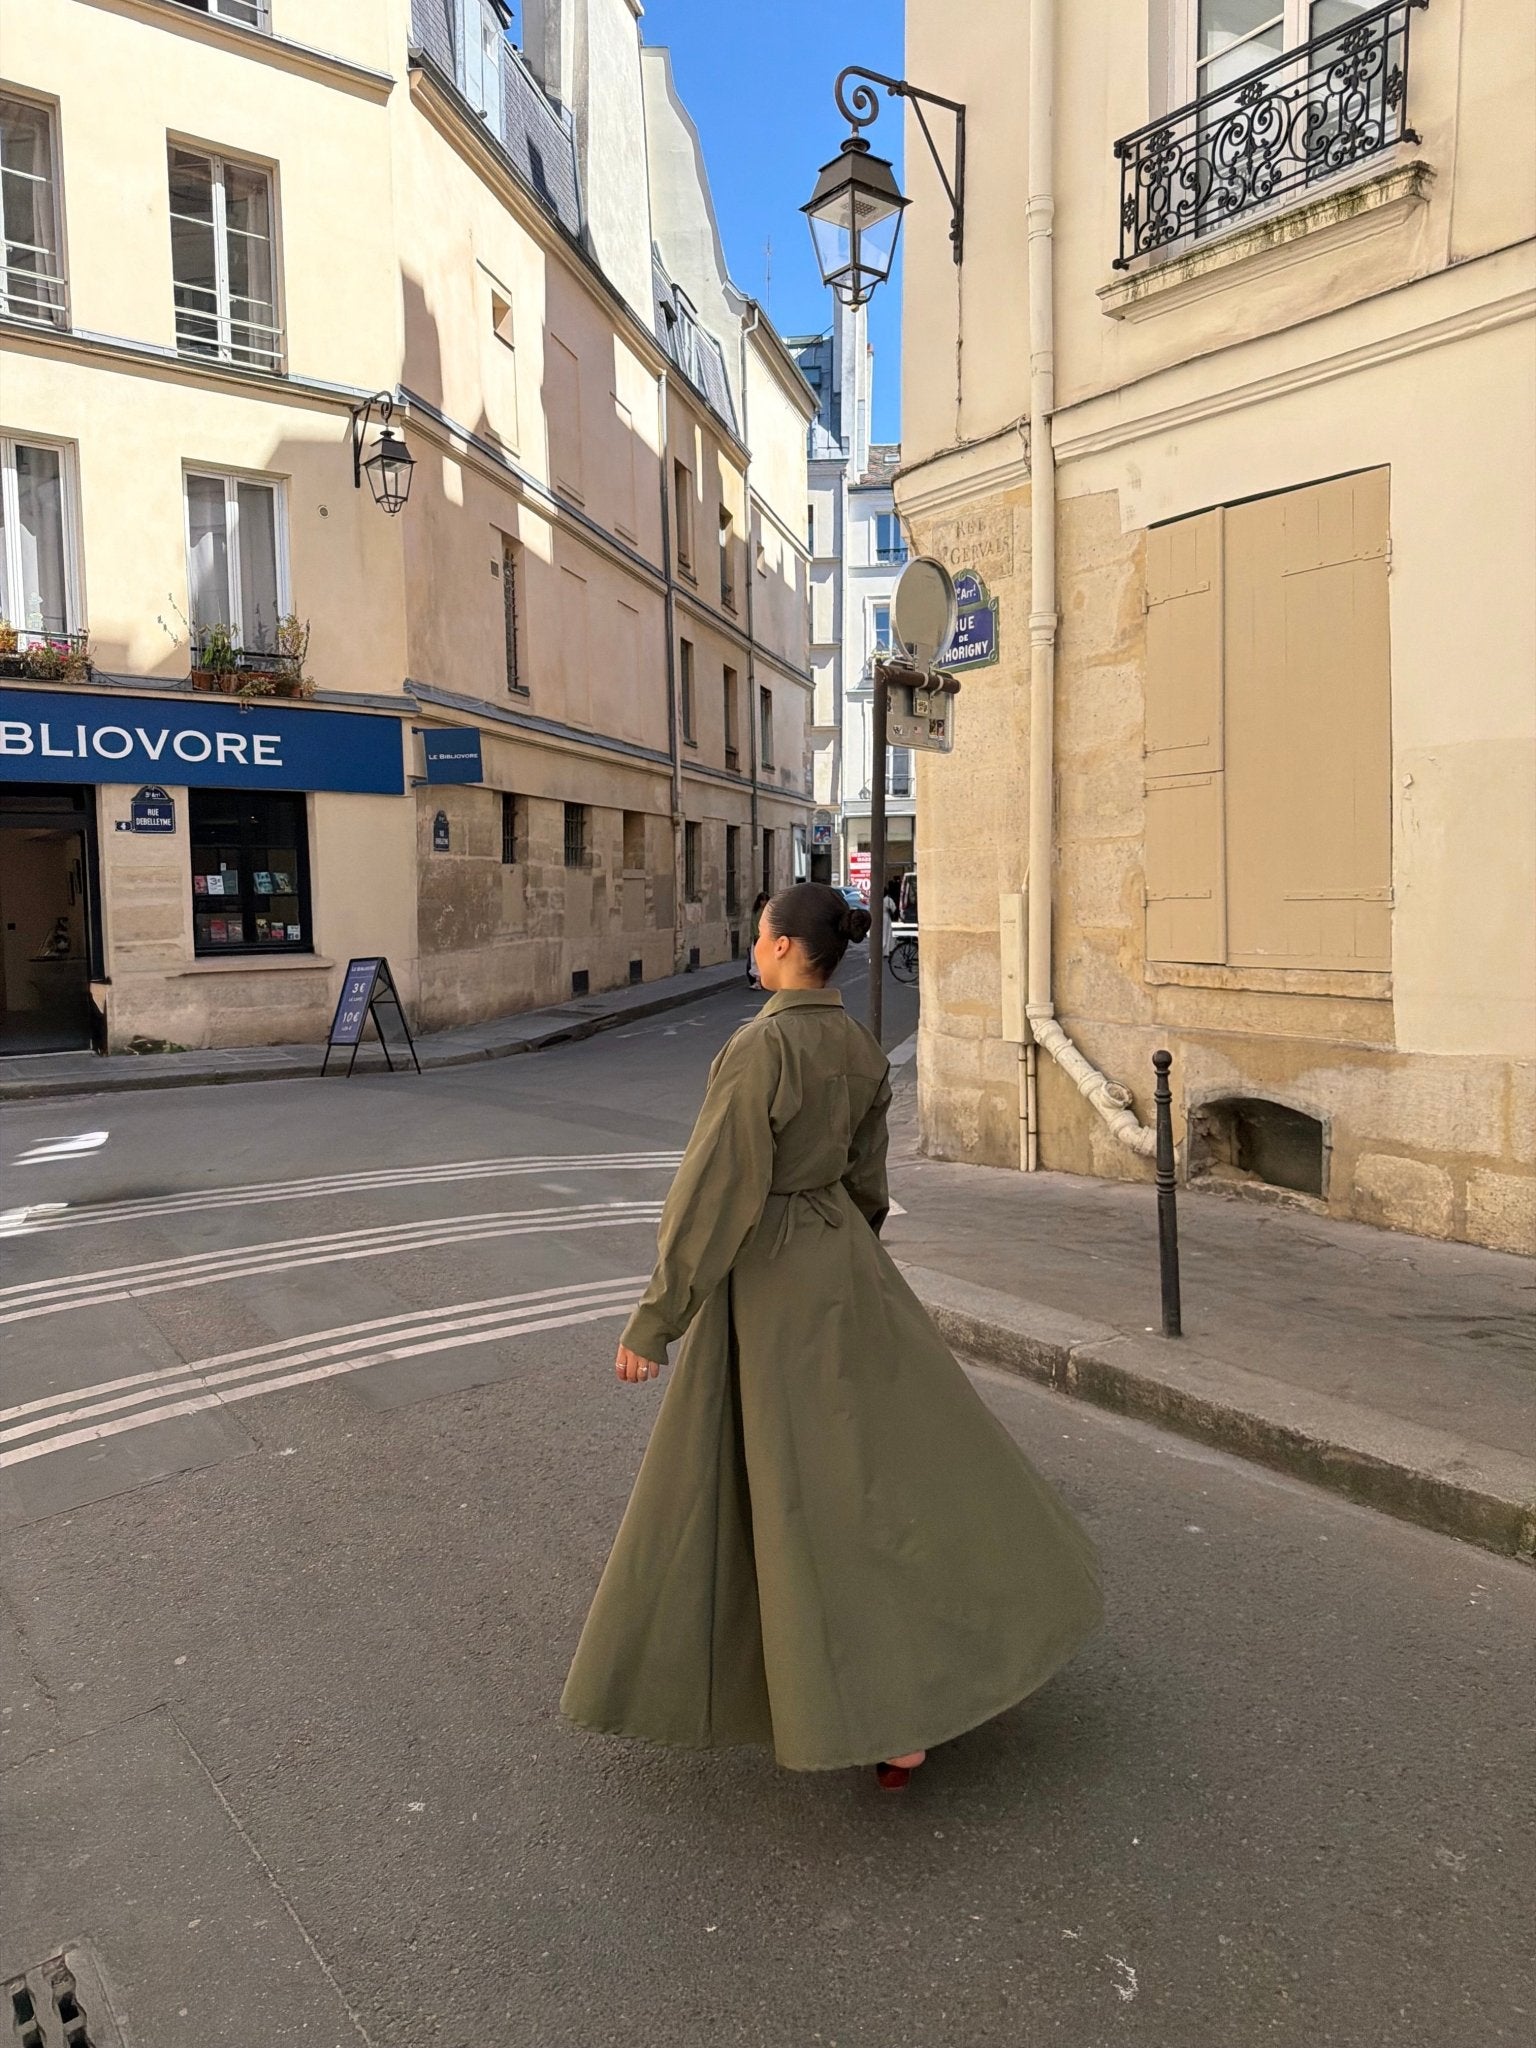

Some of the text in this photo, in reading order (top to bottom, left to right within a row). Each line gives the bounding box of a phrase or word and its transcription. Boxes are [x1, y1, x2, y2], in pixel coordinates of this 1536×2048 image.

[958, 634, 969, 643] DE
[0, 720, 283, 766] BLIOVORE
[147, 808, 159, 816] RUE
[120, 822, 127, 830] 4
[136, 817, 171, 826] DEBELLEYME
[352, 983, 366, 994] 3€
[342, 1012, 360, 1023] 10€
